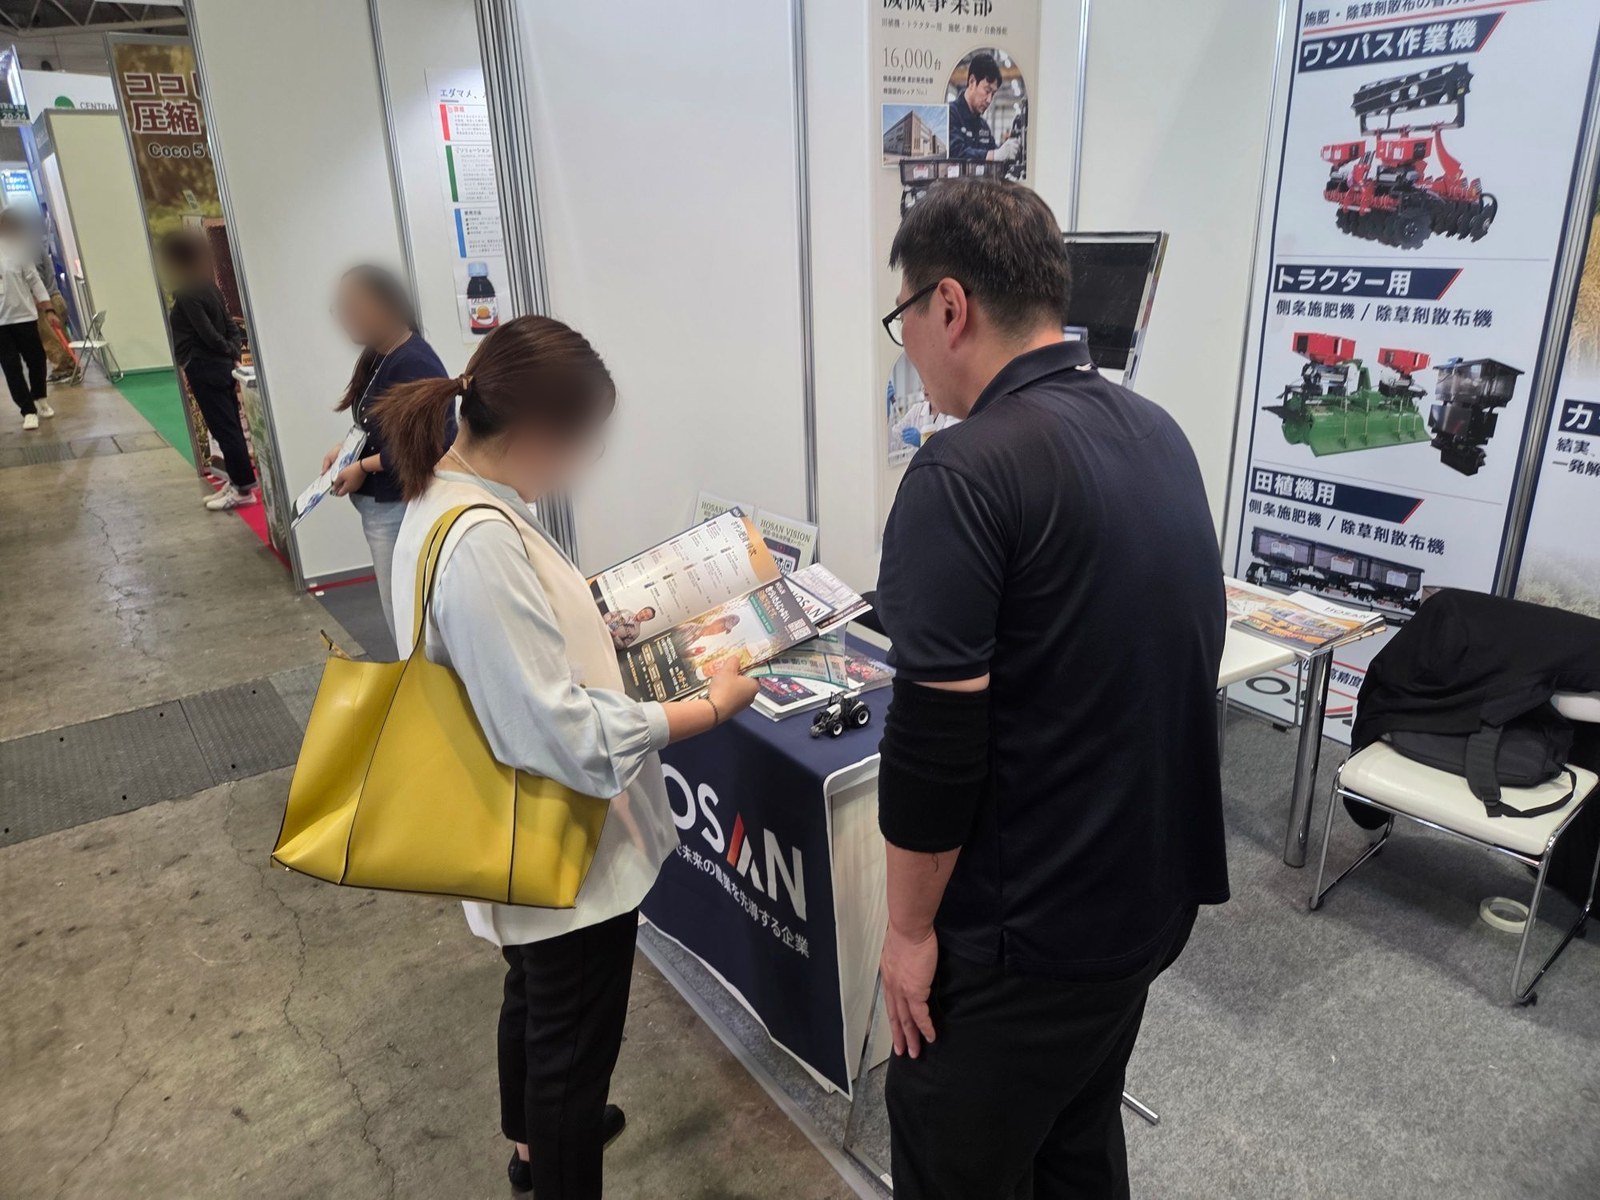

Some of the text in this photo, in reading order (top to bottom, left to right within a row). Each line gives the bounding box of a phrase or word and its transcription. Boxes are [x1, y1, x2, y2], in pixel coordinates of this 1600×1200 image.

[1304, 0, 1475, 26] 施肥・除草剤散布の
[1303, 18, 1478, 67] ワンパス作業機
[884, 47, 941, 72] 16,000台
[440, 88, 486, 98] エダマメ、
[130, 100, 201, 135] 圧縮
[148, 142, 191, 158] Coco
[1276, 267, 1412, 296] トラクター用
[1276, 299, 1355, 320] 側条施肥機
[1375, 304, 1494, 328] 除草剤散布機
[1564, 403, 1600, 430] カ
[1254, 470, 1336, 506] 田植機用
[760, 520, 784, 533] HOSAN
[786, 528, 812, 543] VISION
[1249, 499, 1322, 528] 側条施肥機
[1341, 518, 1445, 556] 除草剤散布機
